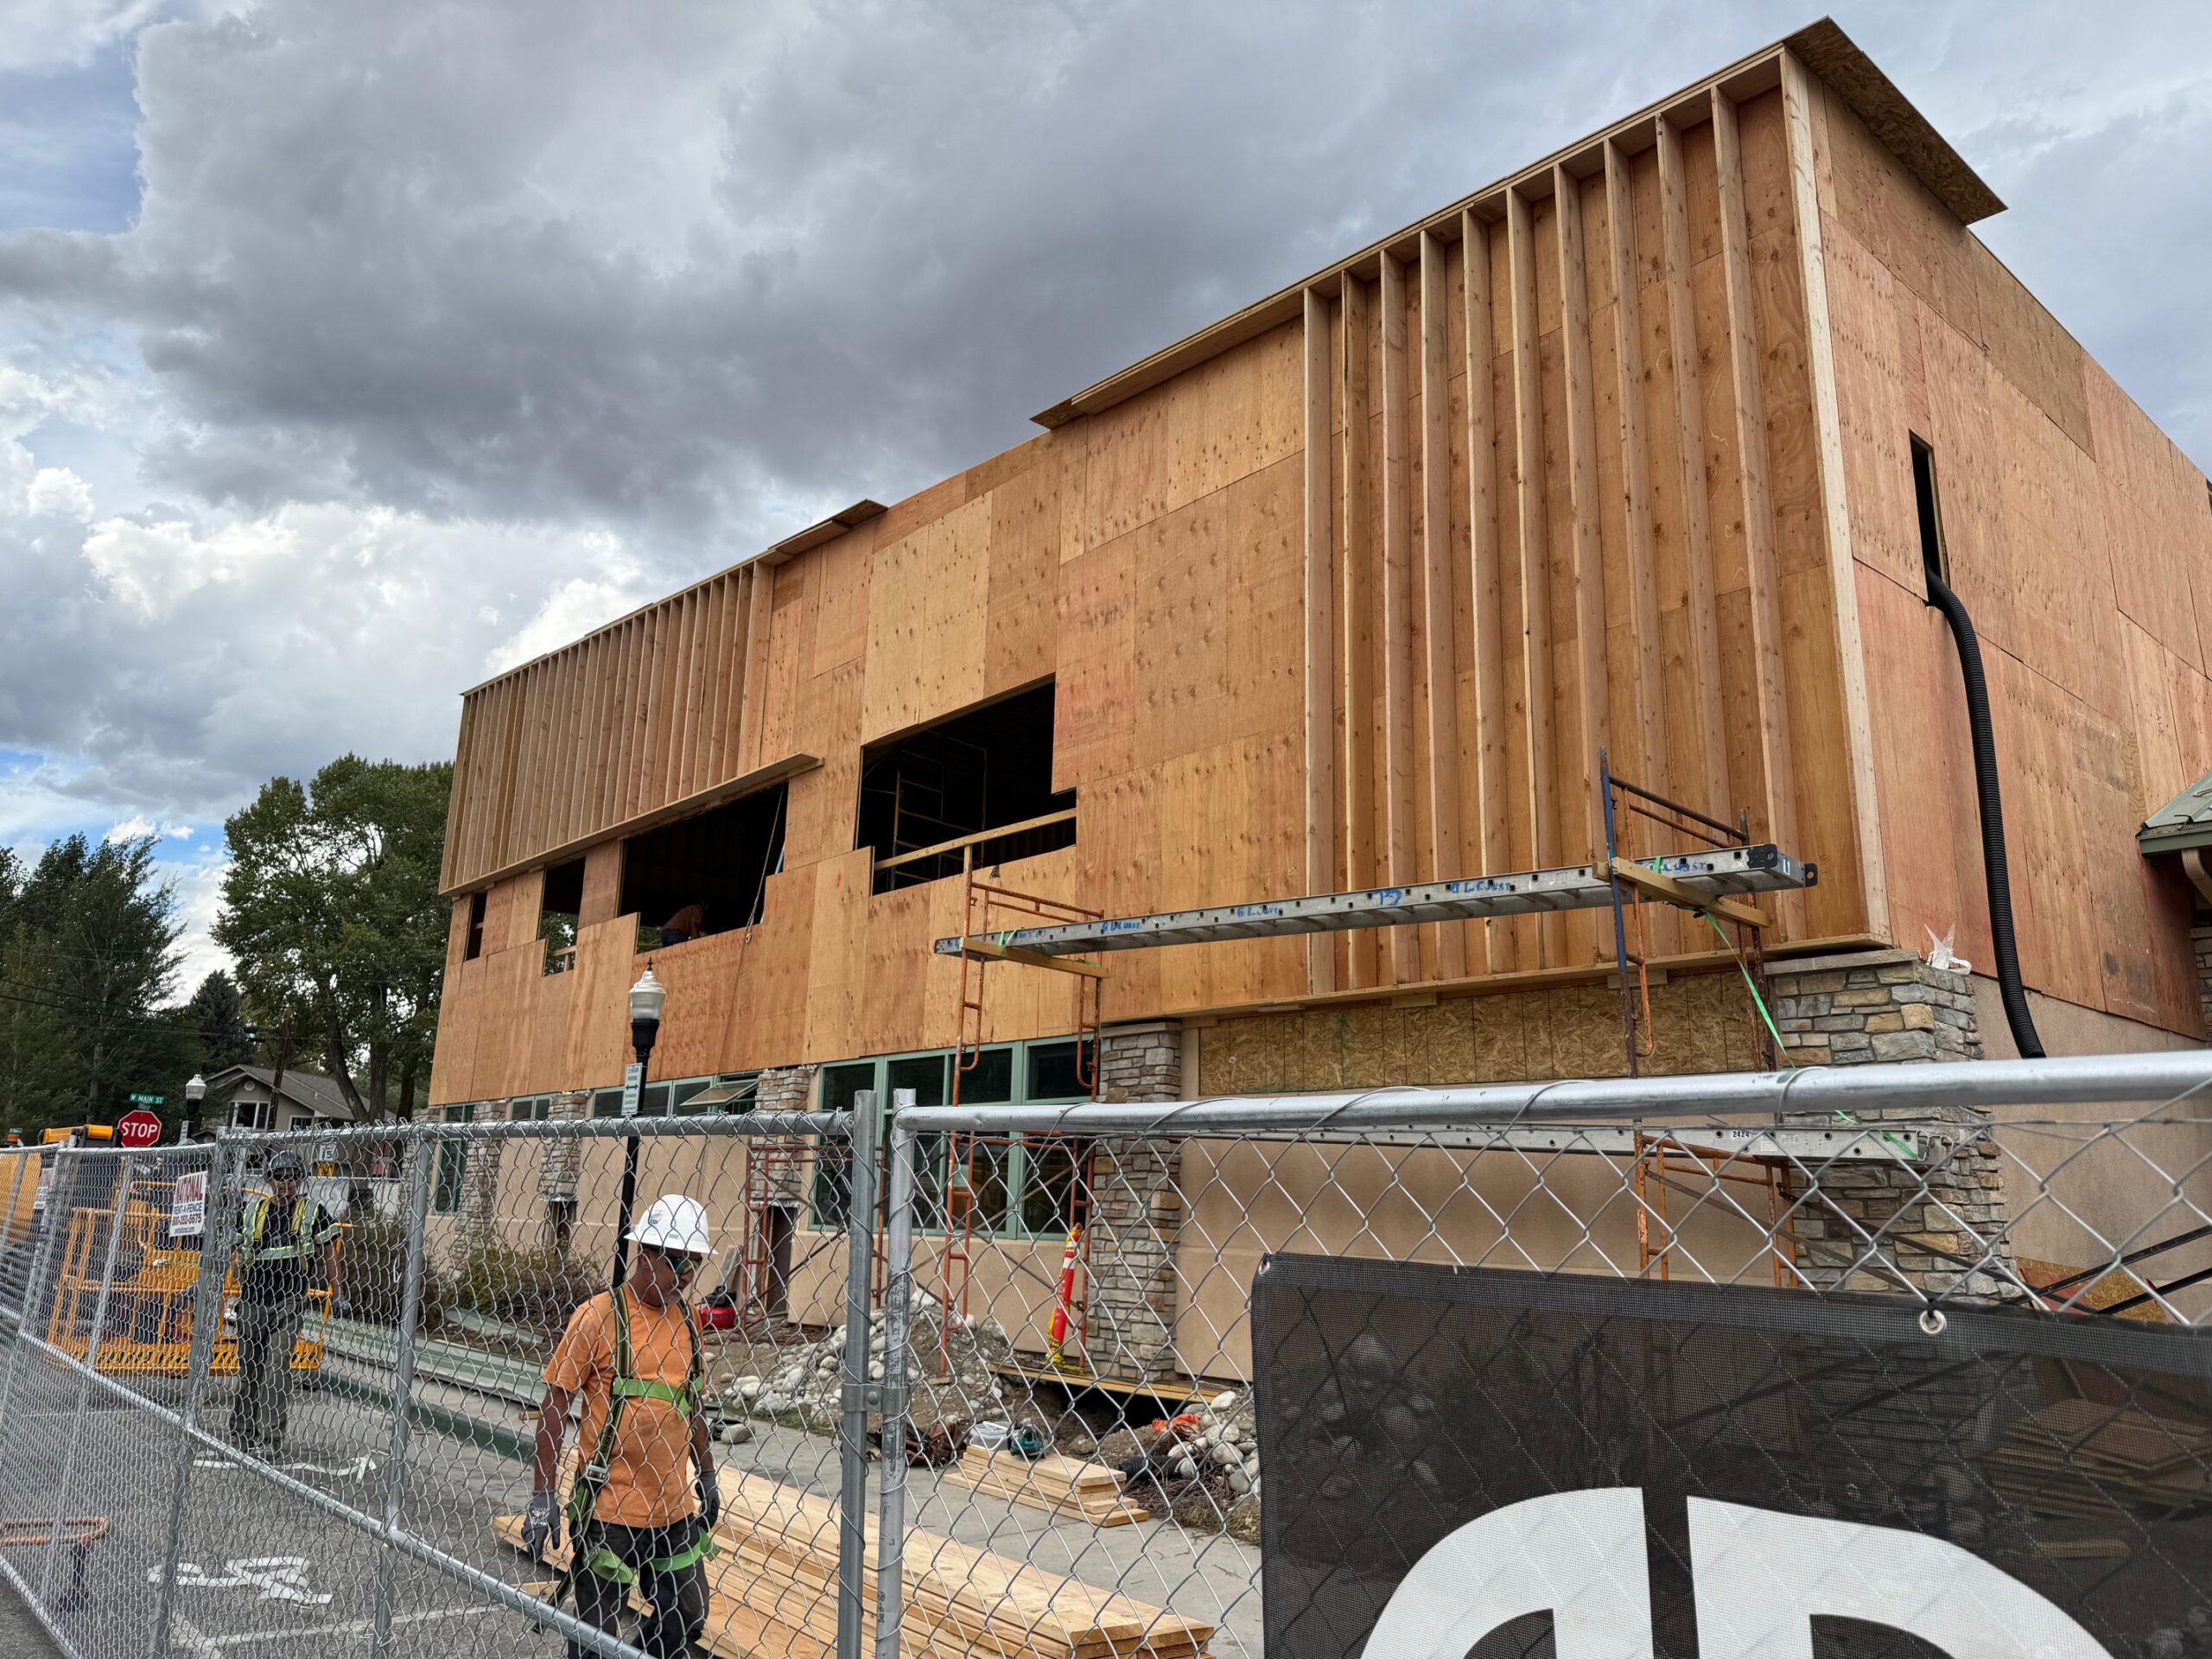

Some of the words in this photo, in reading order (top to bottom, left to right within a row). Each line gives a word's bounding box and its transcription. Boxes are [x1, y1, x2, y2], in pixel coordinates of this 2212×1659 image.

[138, 1095, 153, 1103] MAIN
[121, 1122, 158, 1138] STOP
[174, 1174, 203, 1204] NATIONAL
